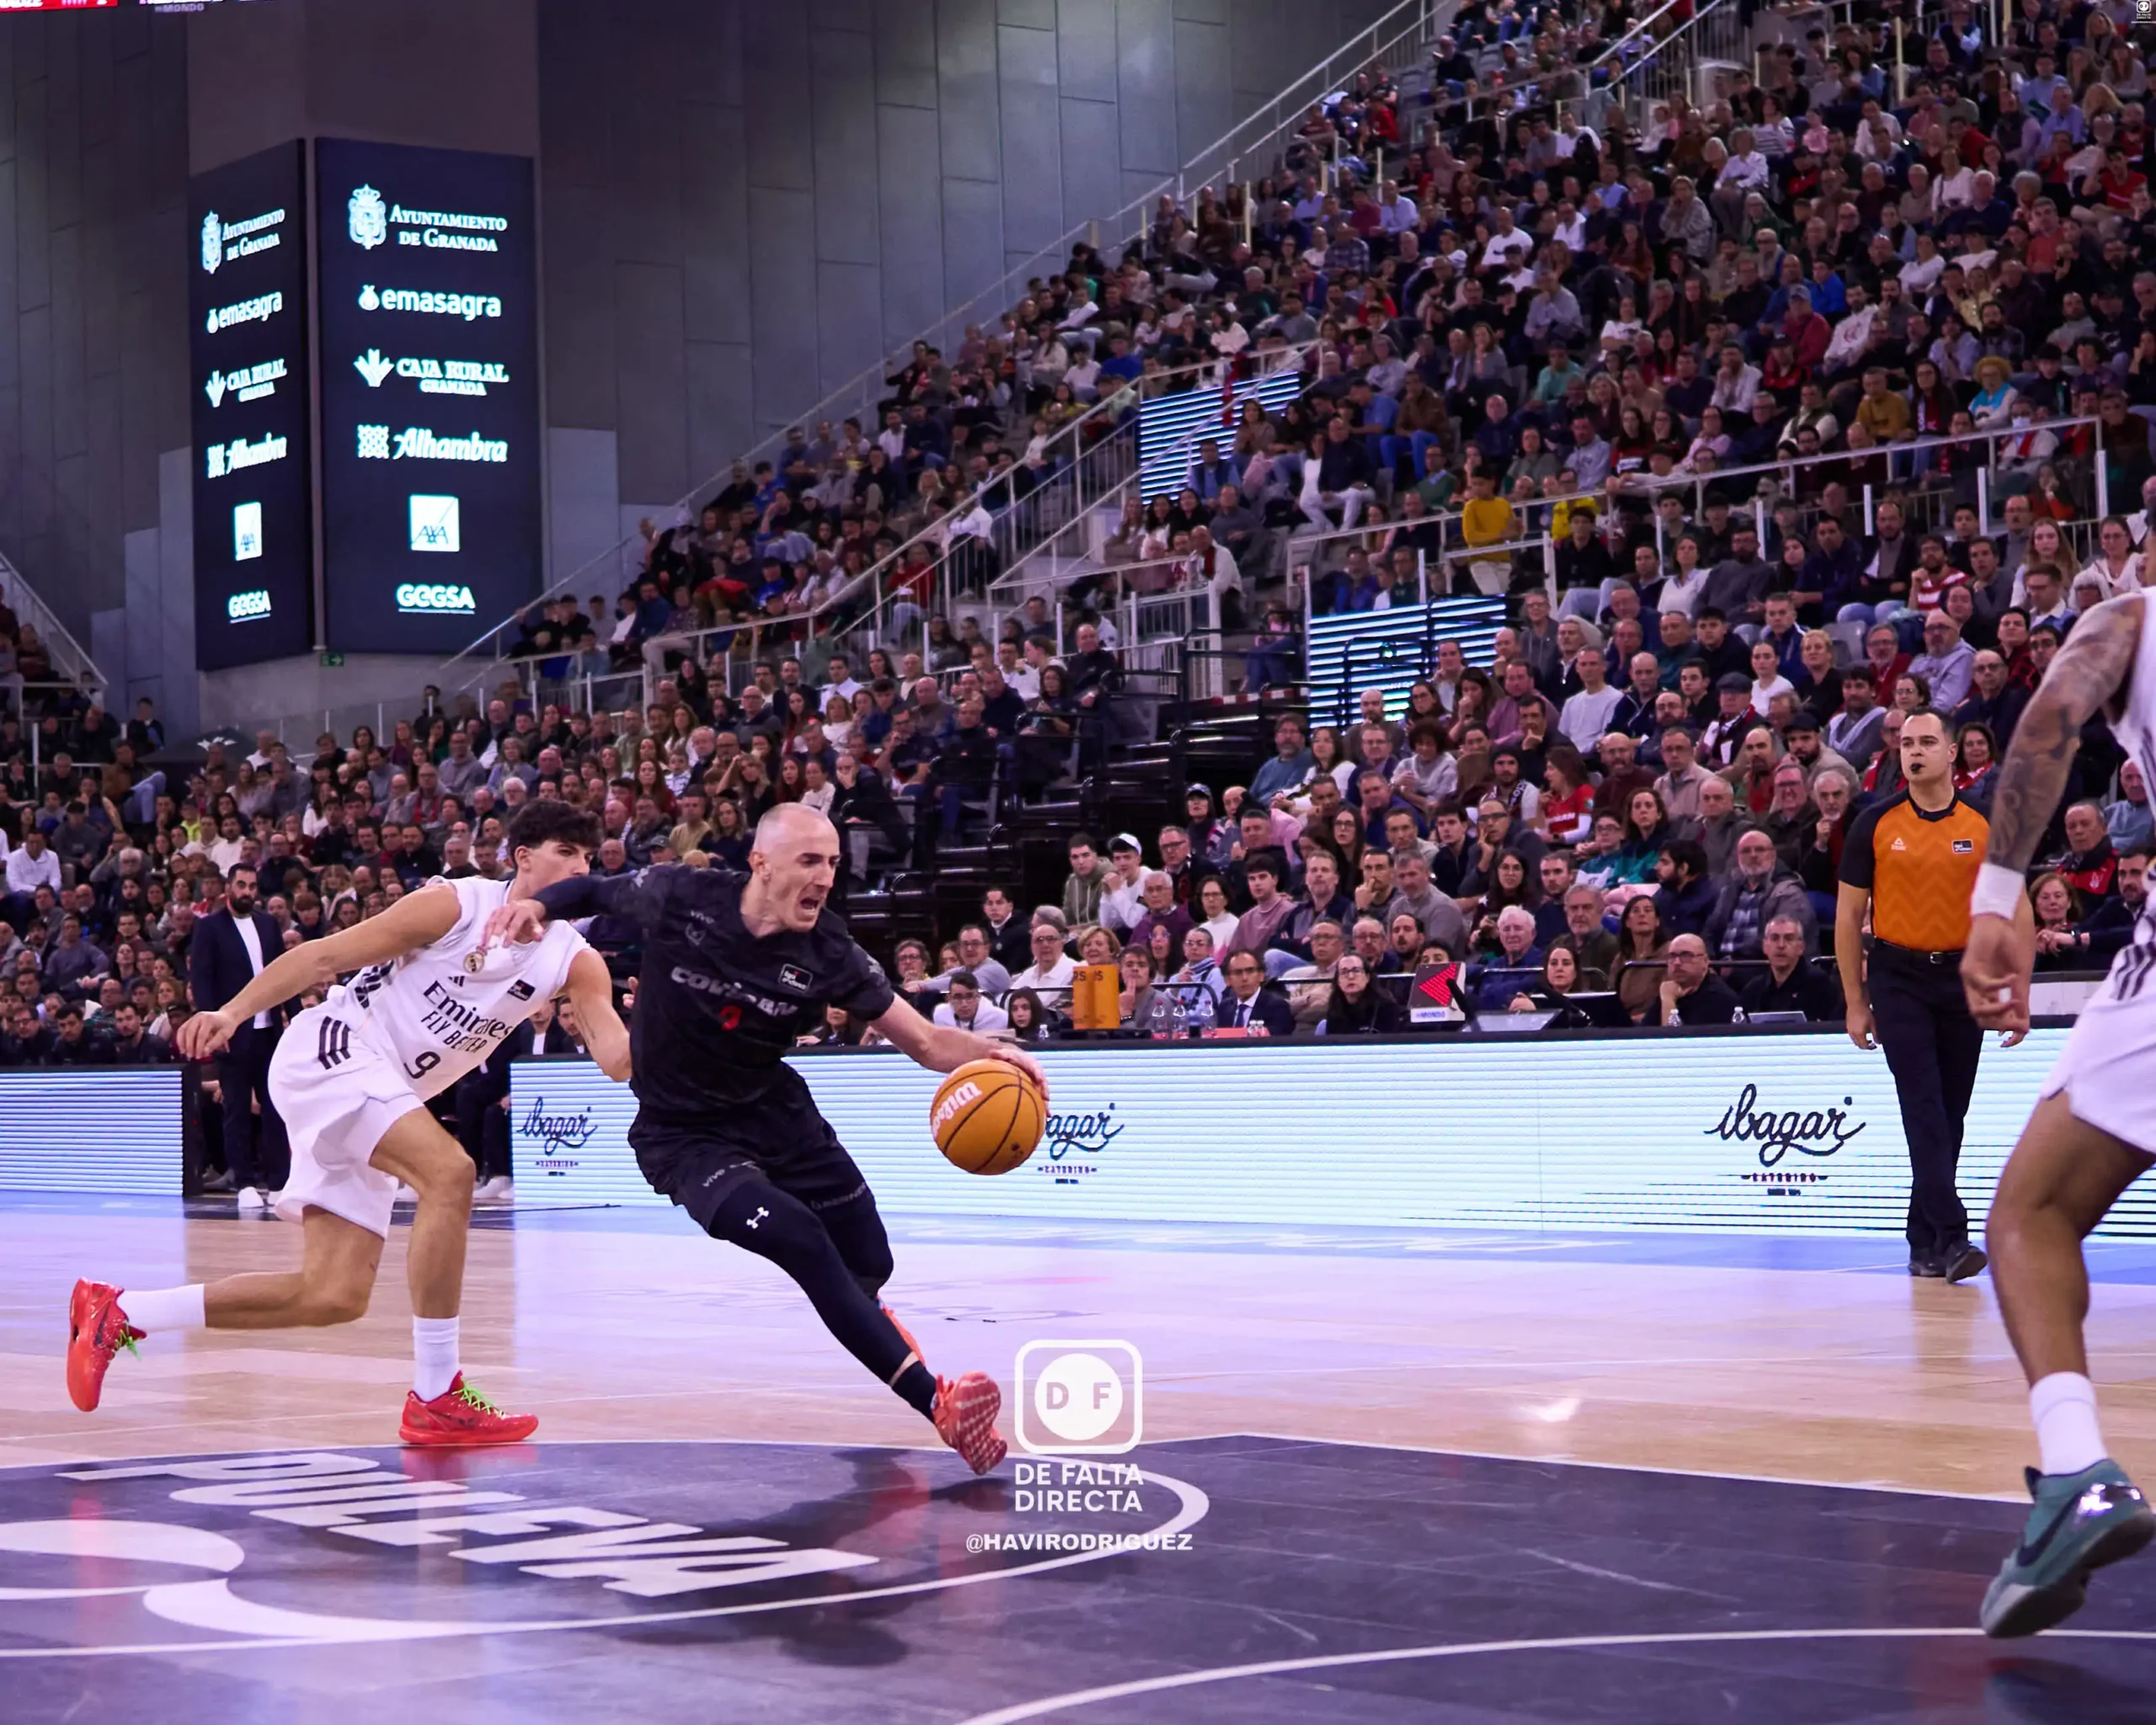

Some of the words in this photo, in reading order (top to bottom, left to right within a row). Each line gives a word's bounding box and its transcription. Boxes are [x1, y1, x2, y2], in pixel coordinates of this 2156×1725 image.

[163, 3, 205, 13] MONDO
[423, 227, 499, 253] GRANADA
[218, 291, 283, 328] emasagra
[382, 288, 502, 321] emasagra
[227, 367, 251, 392] CAJA
[396, 358, 443, 379] CAJA
[444, 360, 510, 383] RURAL
[225, 431, 287, 475] Alhambra
[392, 427, 509, 462] Alhambra
[414, 525, 449, 544] AXA
[420, 1011, 451, 1034] FLY
[424, 980, 514, 1039] Emirates
[403, 1051, 440, 1079] 9
[54, 1451, 881, 1597] PULEVA
